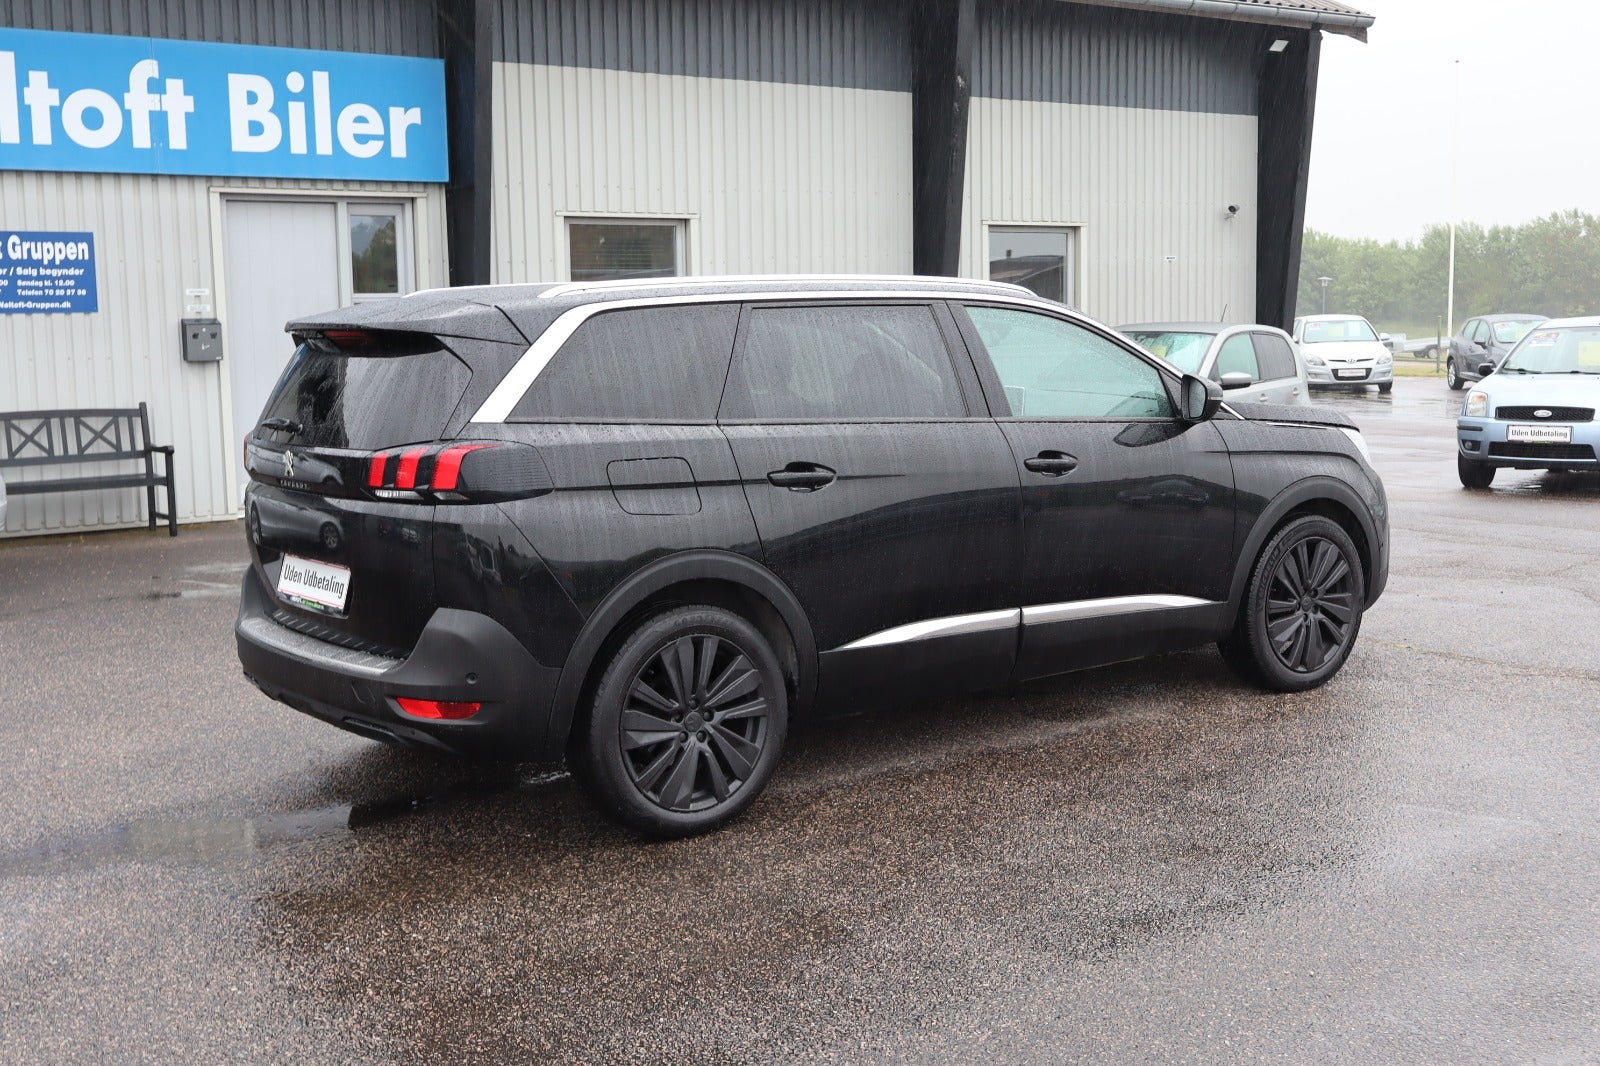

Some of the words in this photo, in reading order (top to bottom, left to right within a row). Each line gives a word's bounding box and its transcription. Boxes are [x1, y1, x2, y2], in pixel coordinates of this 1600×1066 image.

[0, 51, 194, 150] ltoft
[228, 71, 421, 158] Biler
[7, 234, 89, 265] Gruppen
[16, 267, 38, 277] Salg
[39, 267, 85, 277] begynder
[1530, 429, 1568, 438] Udbetaling
[283, 563, 303, 584] Uden
[303, 568, 345, 599] Udbetaling
